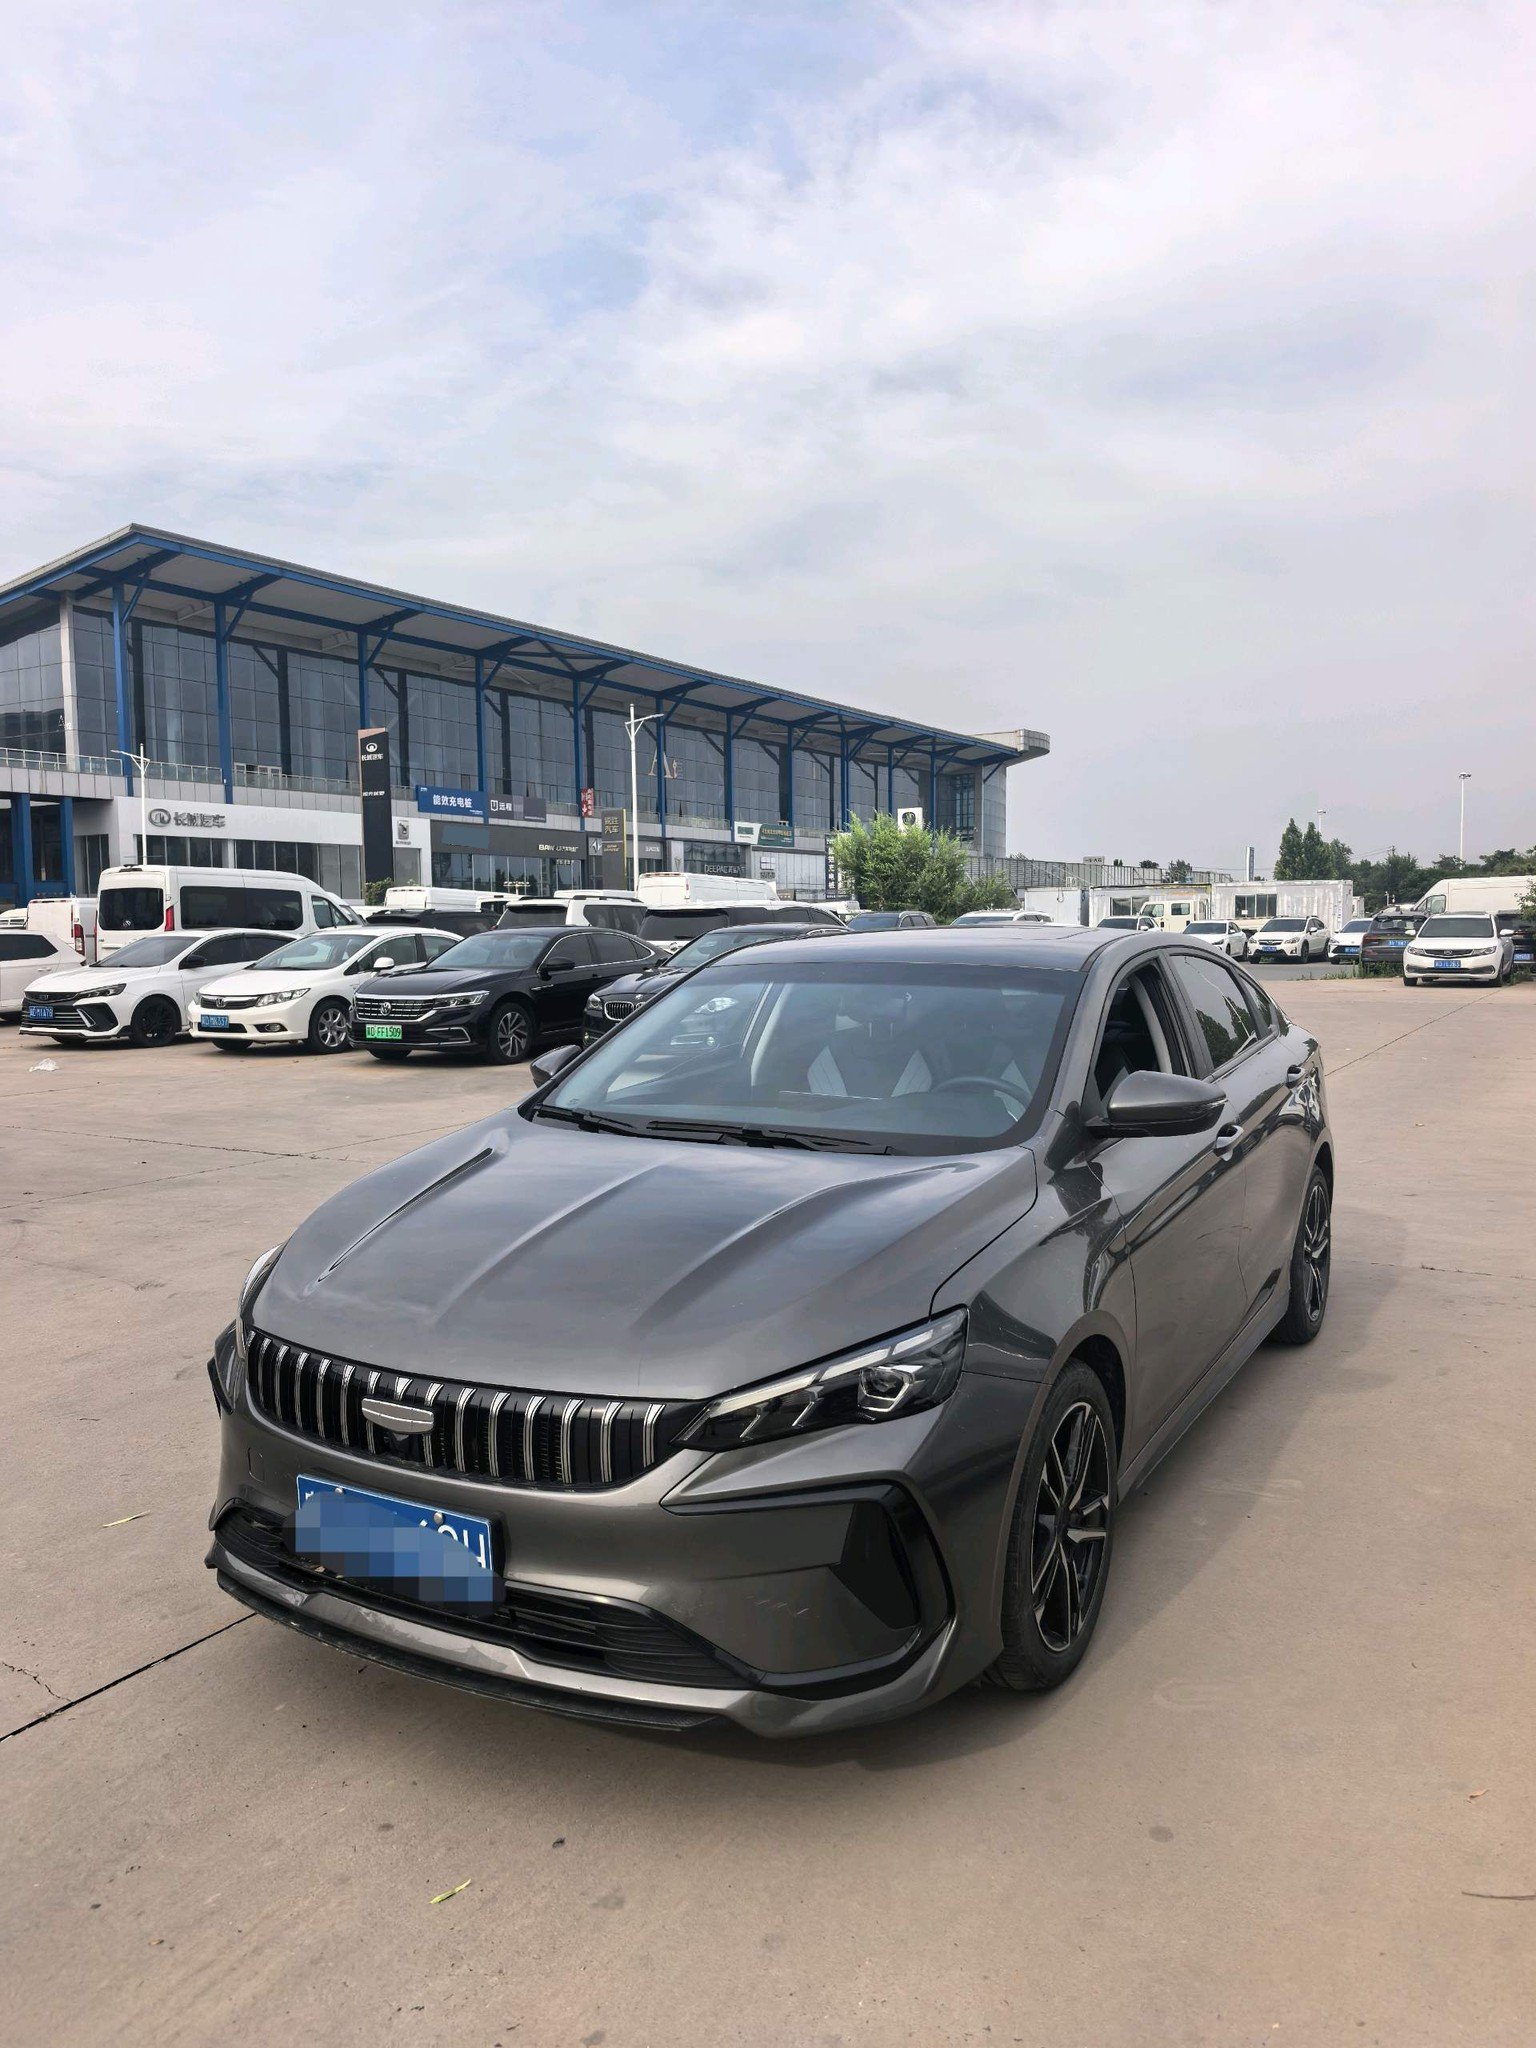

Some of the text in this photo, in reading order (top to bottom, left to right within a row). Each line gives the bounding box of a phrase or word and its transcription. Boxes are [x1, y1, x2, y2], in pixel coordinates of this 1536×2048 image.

[432, 794, 473, 809] 能效充电桩
